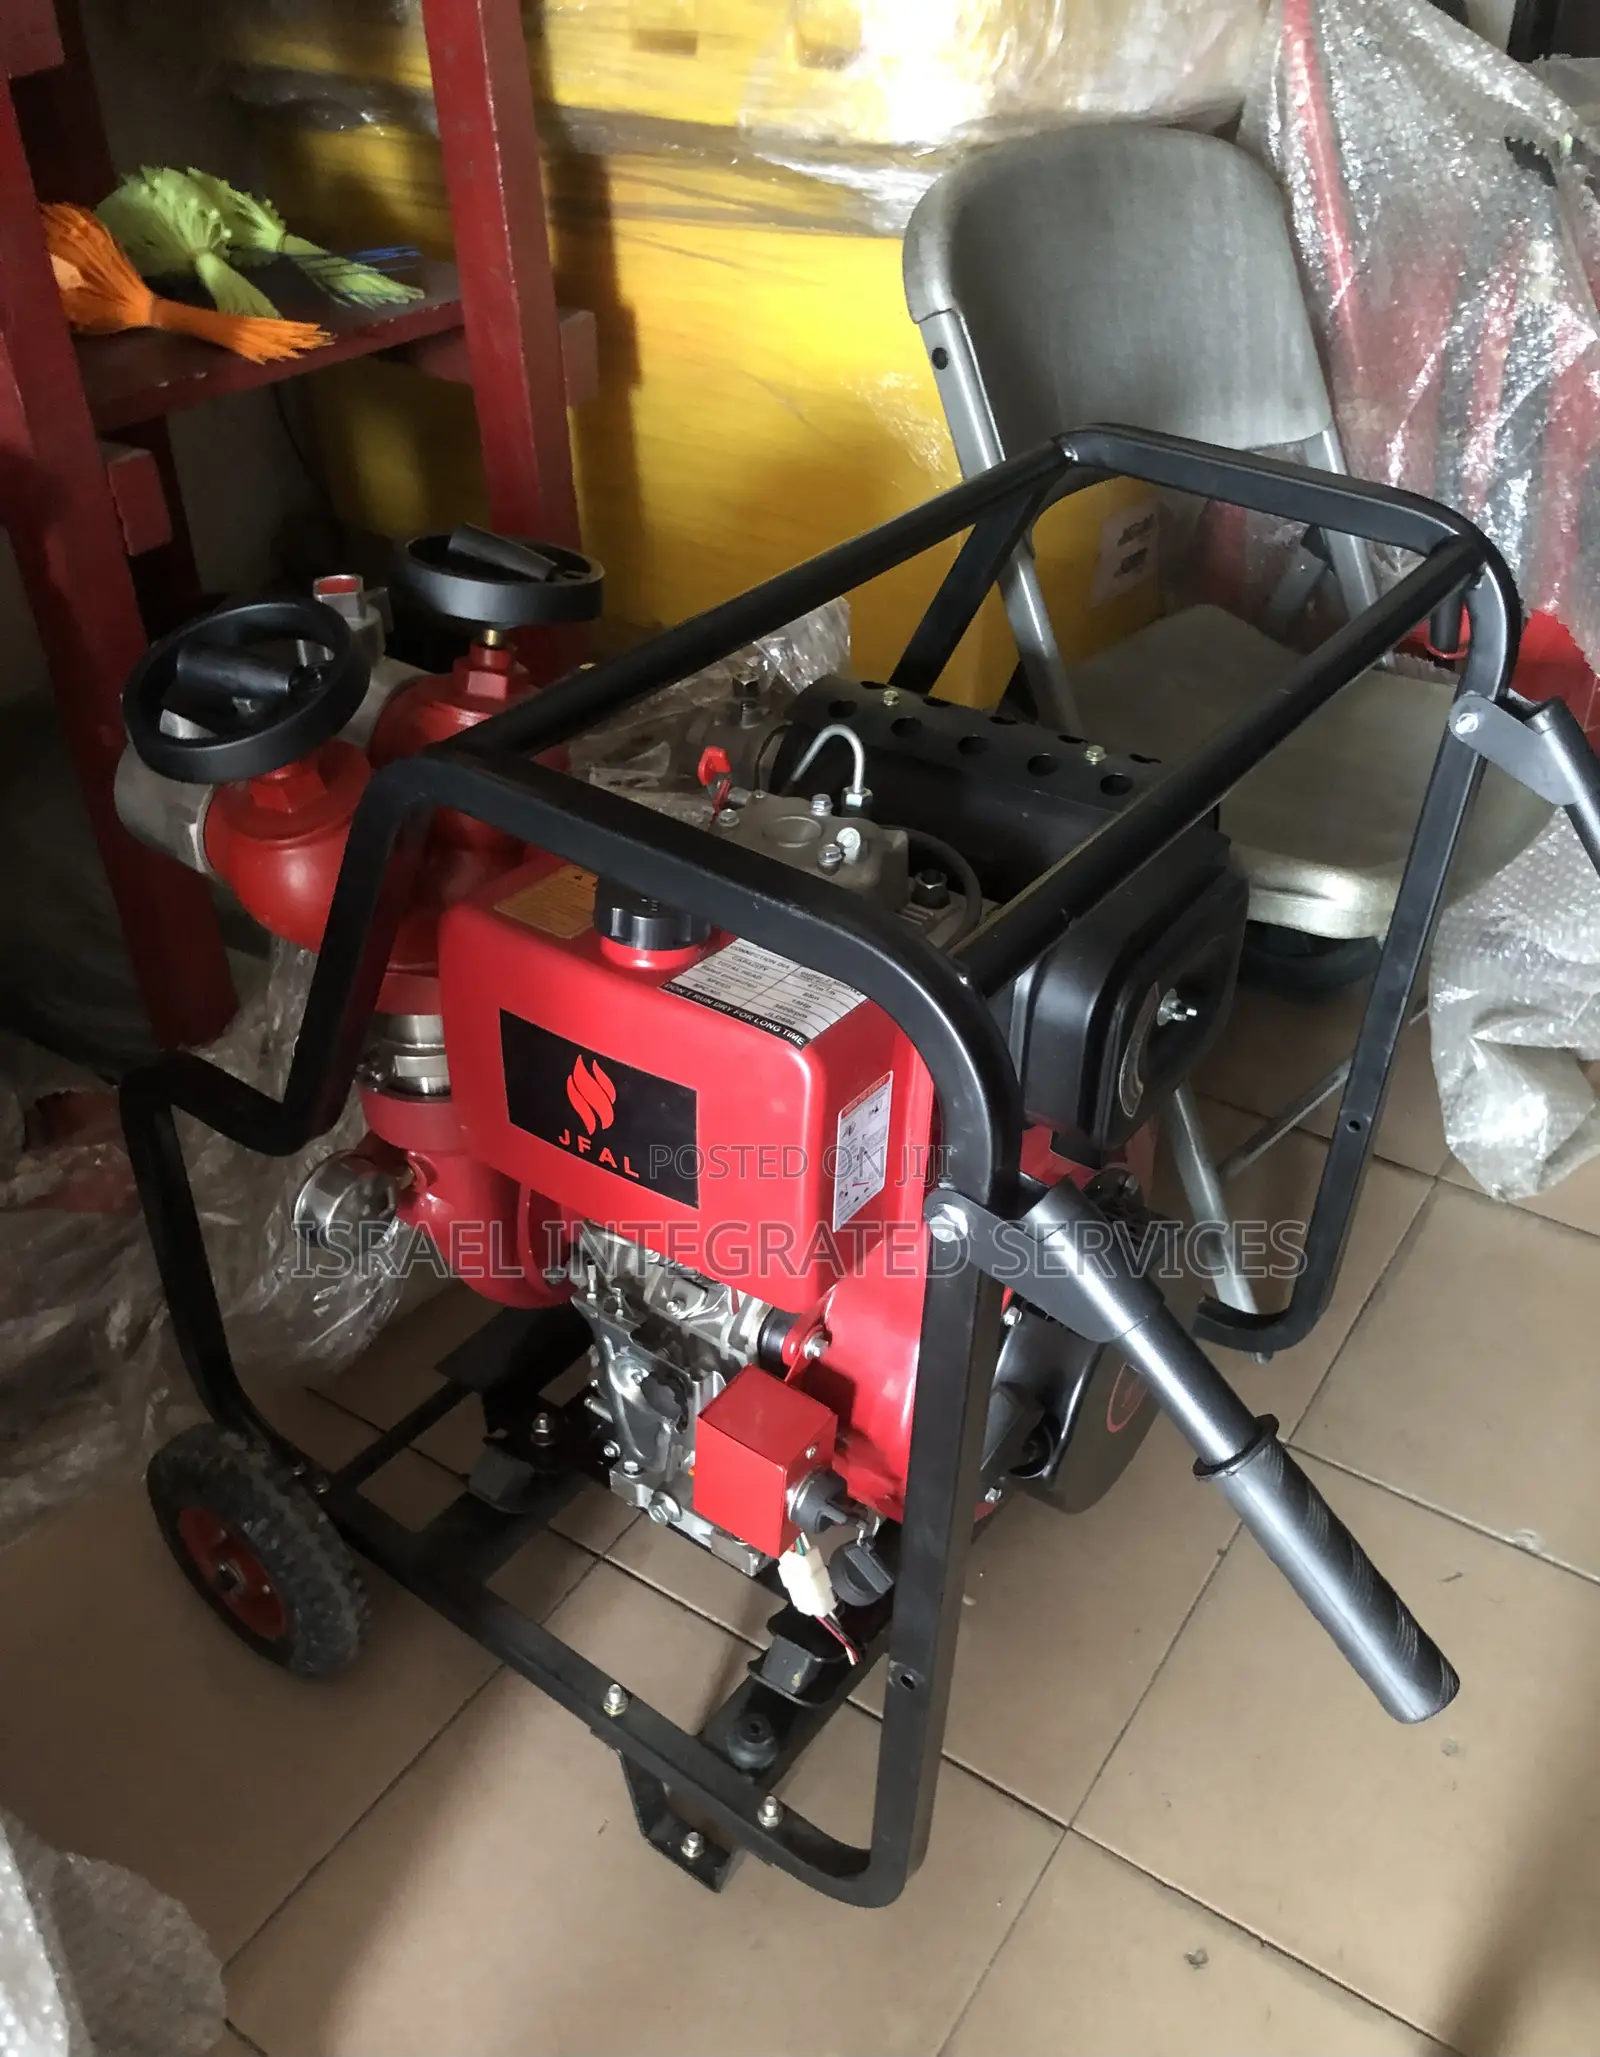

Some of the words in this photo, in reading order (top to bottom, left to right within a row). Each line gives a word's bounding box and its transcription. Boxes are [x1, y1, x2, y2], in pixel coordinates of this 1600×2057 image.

[693, 994, 713, 1004] RUN
[713, 1001, 733, 1012] DRY
[732, 1009, 754, 1021] FOR
[752, 1017, 781, 1032] LONG
[782, 1029, 805, 1046] TIME
[558, 1128, 640, 1178] JFAL
